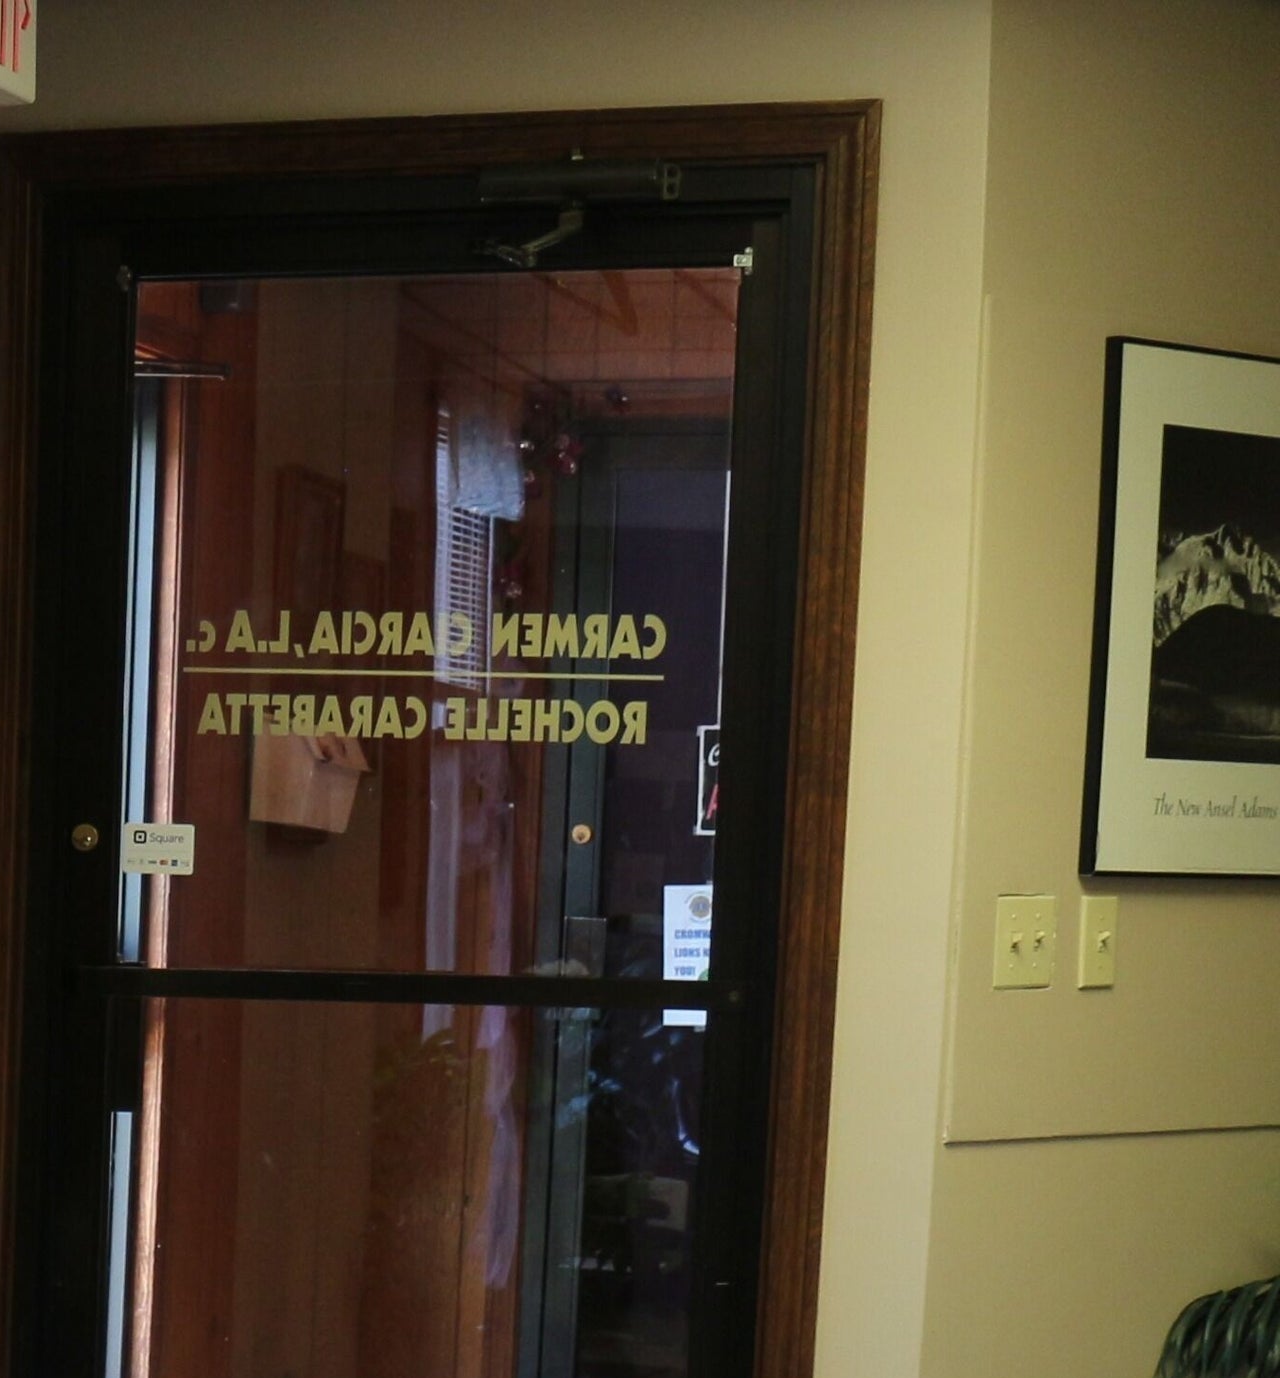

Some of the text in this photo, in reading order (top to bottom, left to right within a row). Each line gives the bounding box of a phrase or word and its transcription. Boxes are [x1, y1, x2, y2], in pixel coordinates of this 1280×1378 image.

[1152, 791, 1279, 818] The New Ansel Adams
[148, 832, 185, 845] Square
